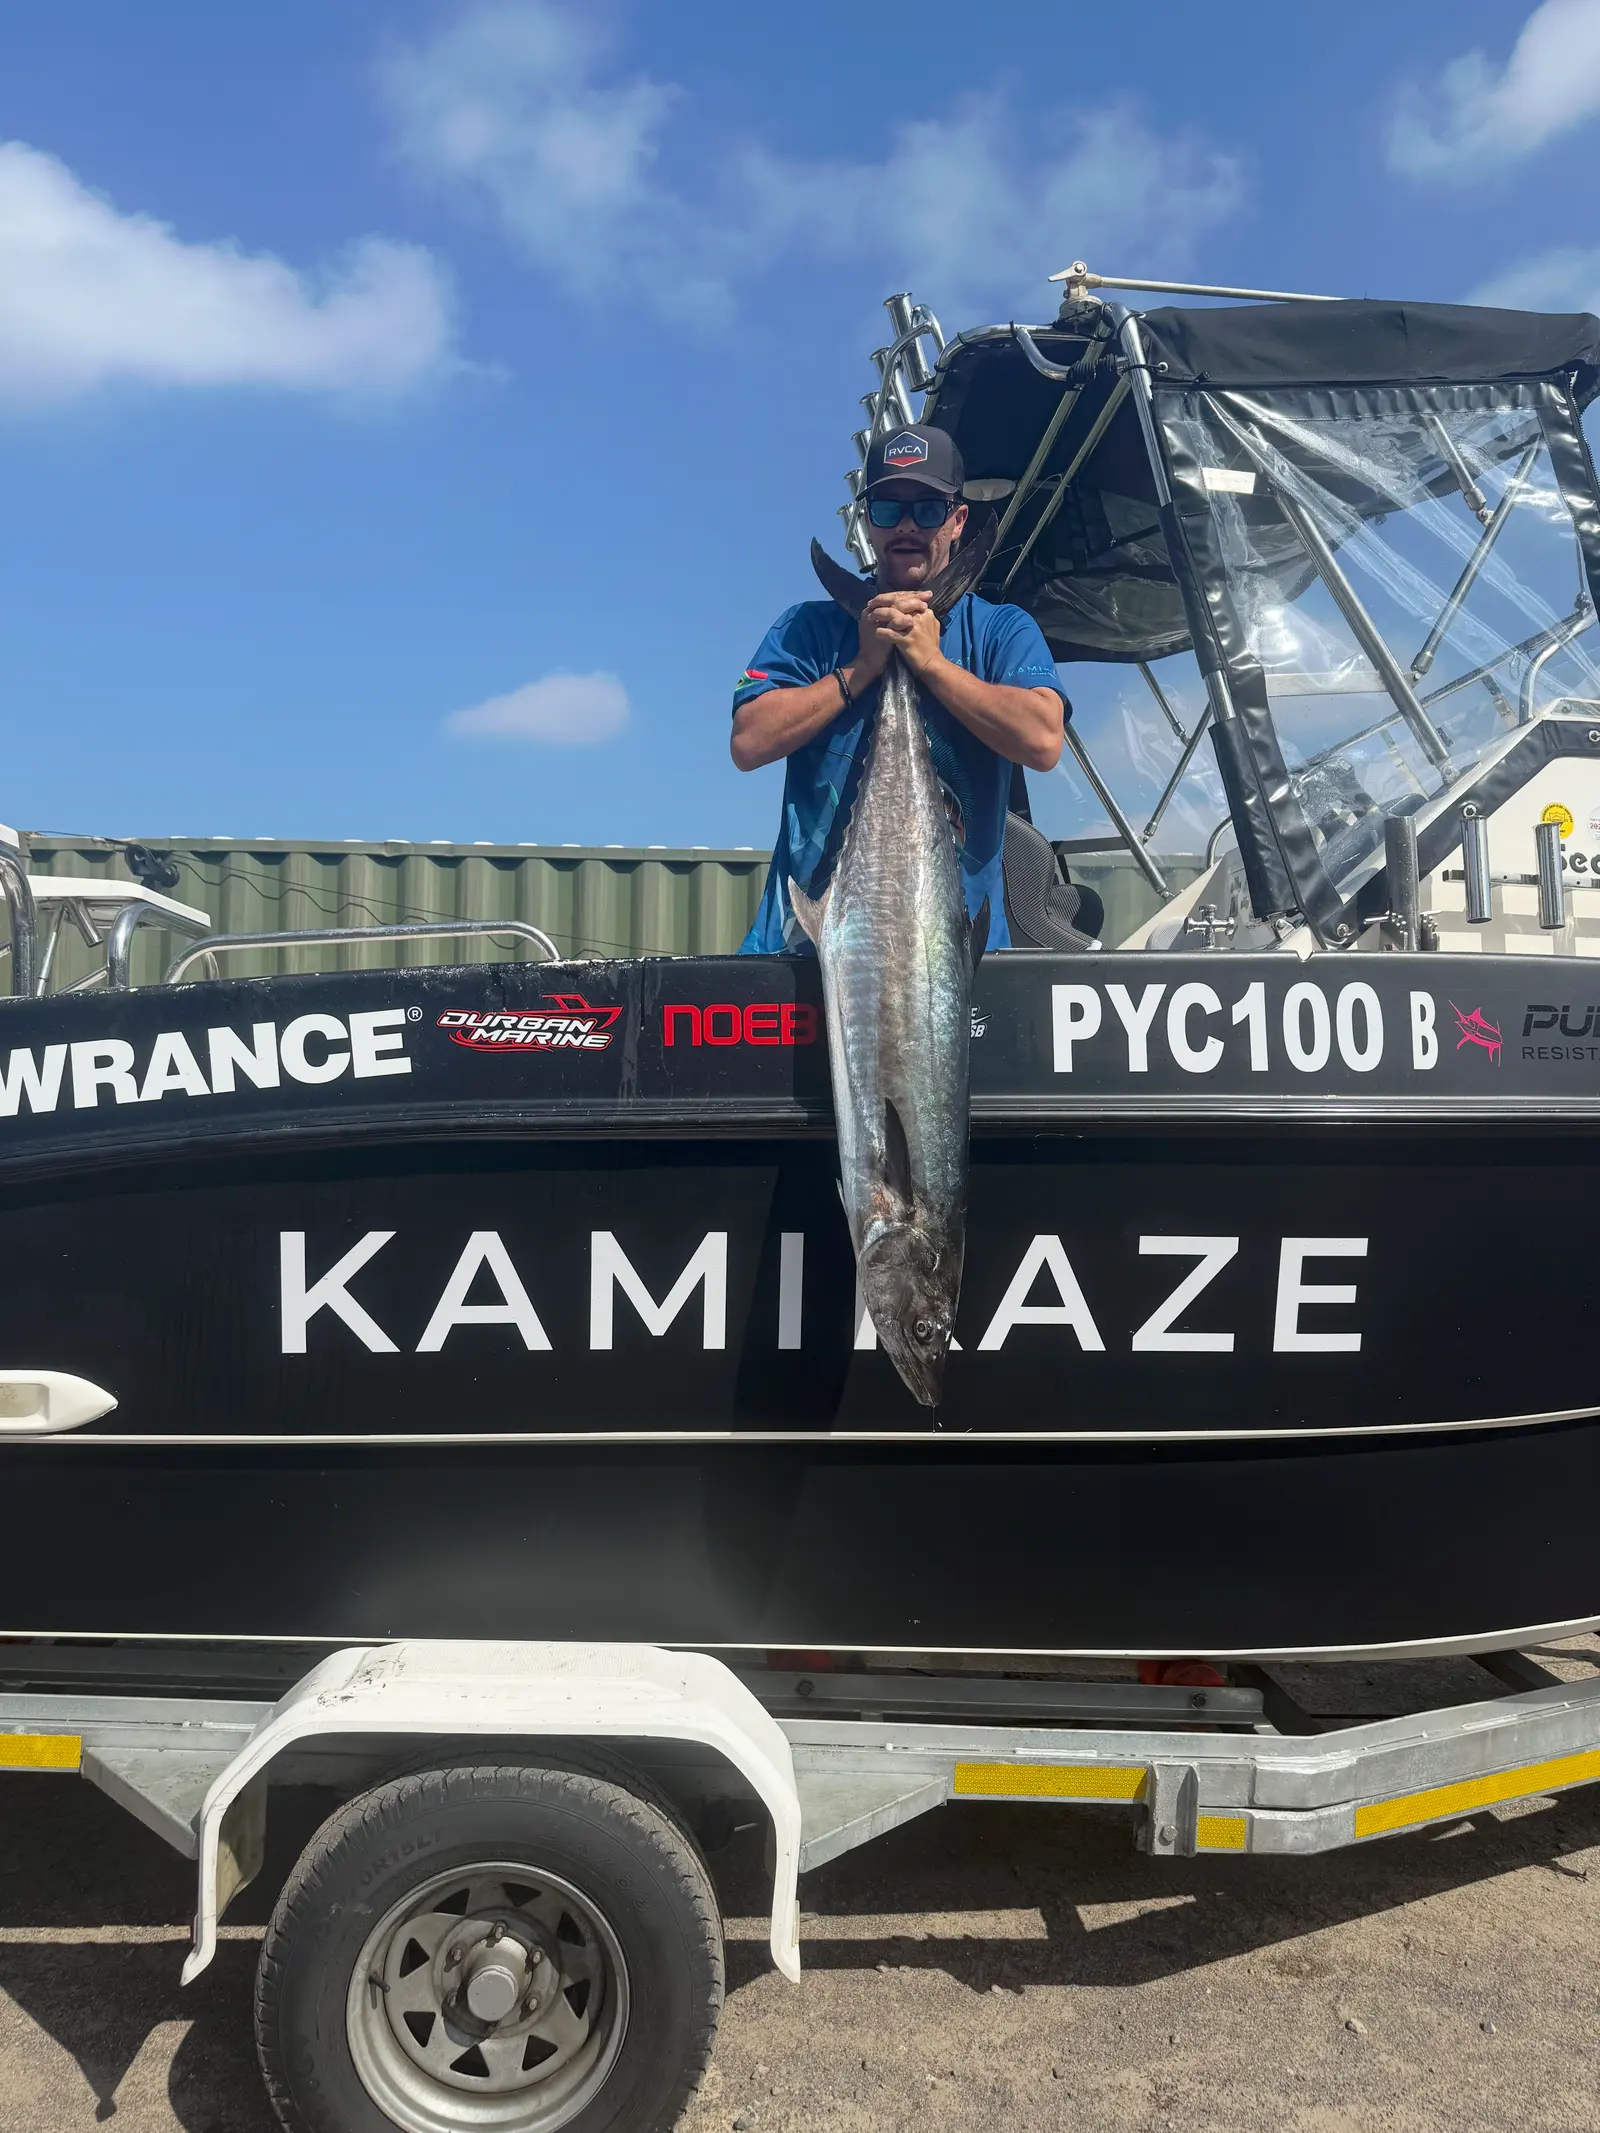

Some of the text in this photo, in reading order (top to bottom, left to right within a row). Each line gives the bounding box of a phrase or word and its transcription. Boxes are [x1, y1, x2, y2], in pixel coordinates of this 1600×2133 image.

[889, 445, 922, 457] RVCA
[439, 1011, 596, 1033] DURBAN
[1051, 982, 1439, 1074] PYC100 B
[471, 1028, 612, 1048] MARINE
[1522, 1046, 1600, 1060] RESIST
[279, 1230, 1369, 1355] KAMIAZE
